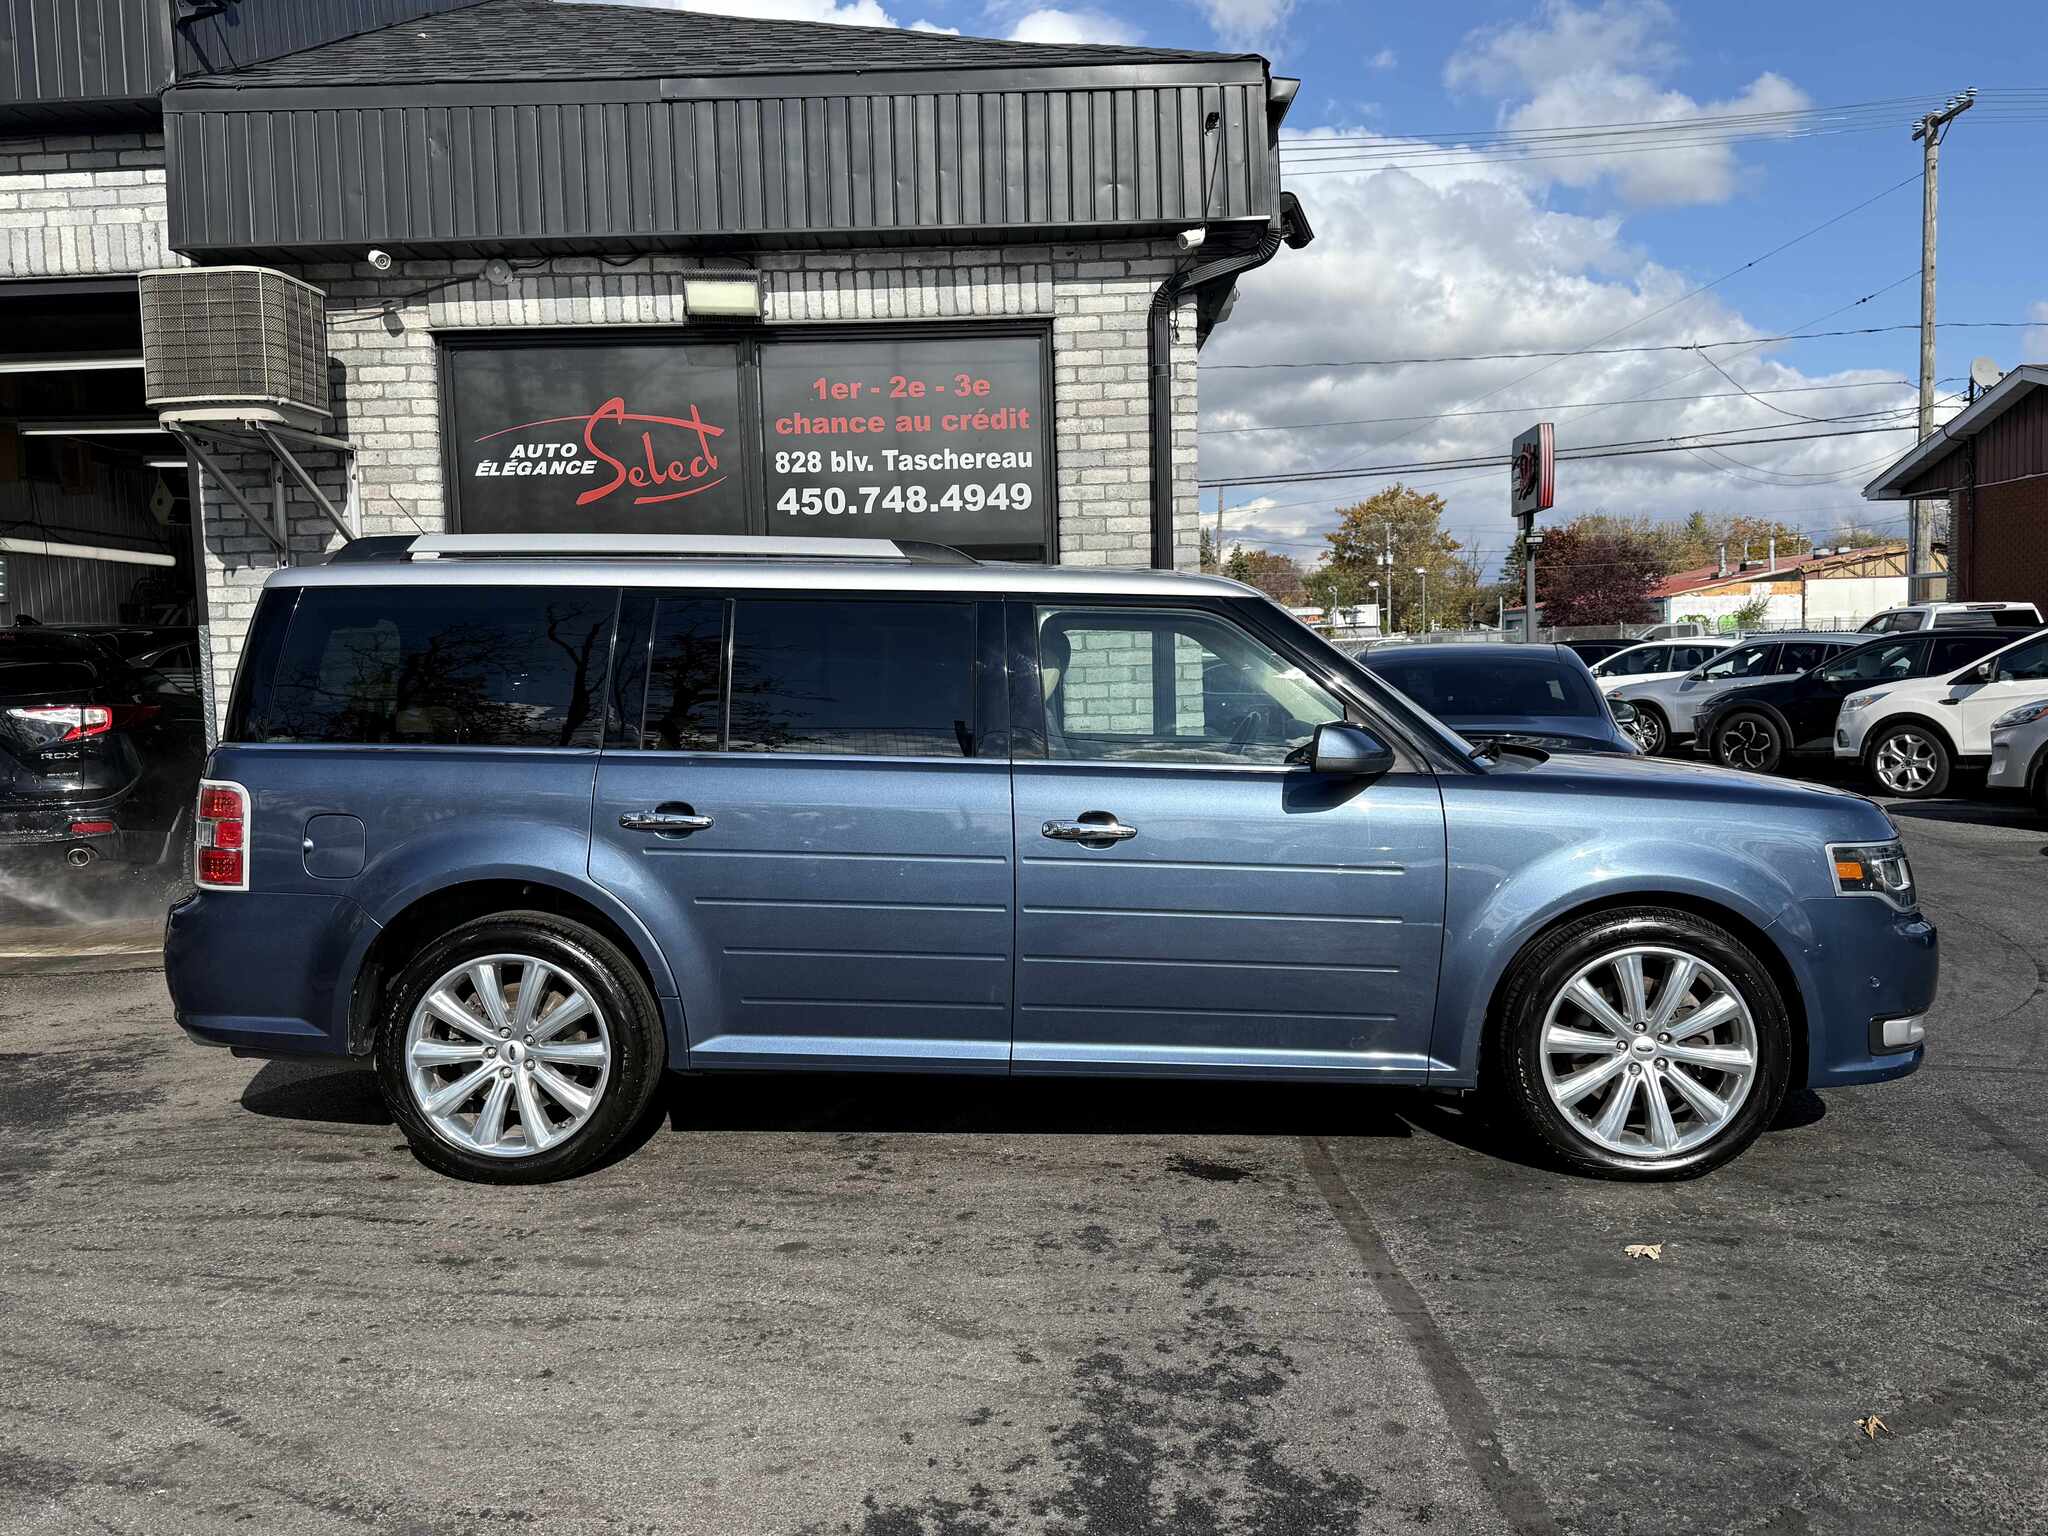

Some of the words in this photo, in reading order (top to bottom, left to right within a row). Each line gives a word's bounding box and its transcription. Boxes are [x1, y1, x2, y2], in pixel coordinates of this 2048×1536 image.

[812, 377, 862, 401] 1er
[889, 375, 926, 400] 2e
[954, 373, 991, 398] 3e
[775, 412, 886, 436] chance
[895, 415, 931, 433] au
[942, 407, 1031, 433] crédit
[509, 442, 578, 460] AUTO
[575, 397, 724, 506] Select
[775, 450, 823, 474] 828
[830, 449, 874, 473] blv.
[881, 447, 1034, 472] Taschereau
[475, 459, 598, 477] ÉLÉGANCE
[776, 482, 1033, 516] 450.748.4949
